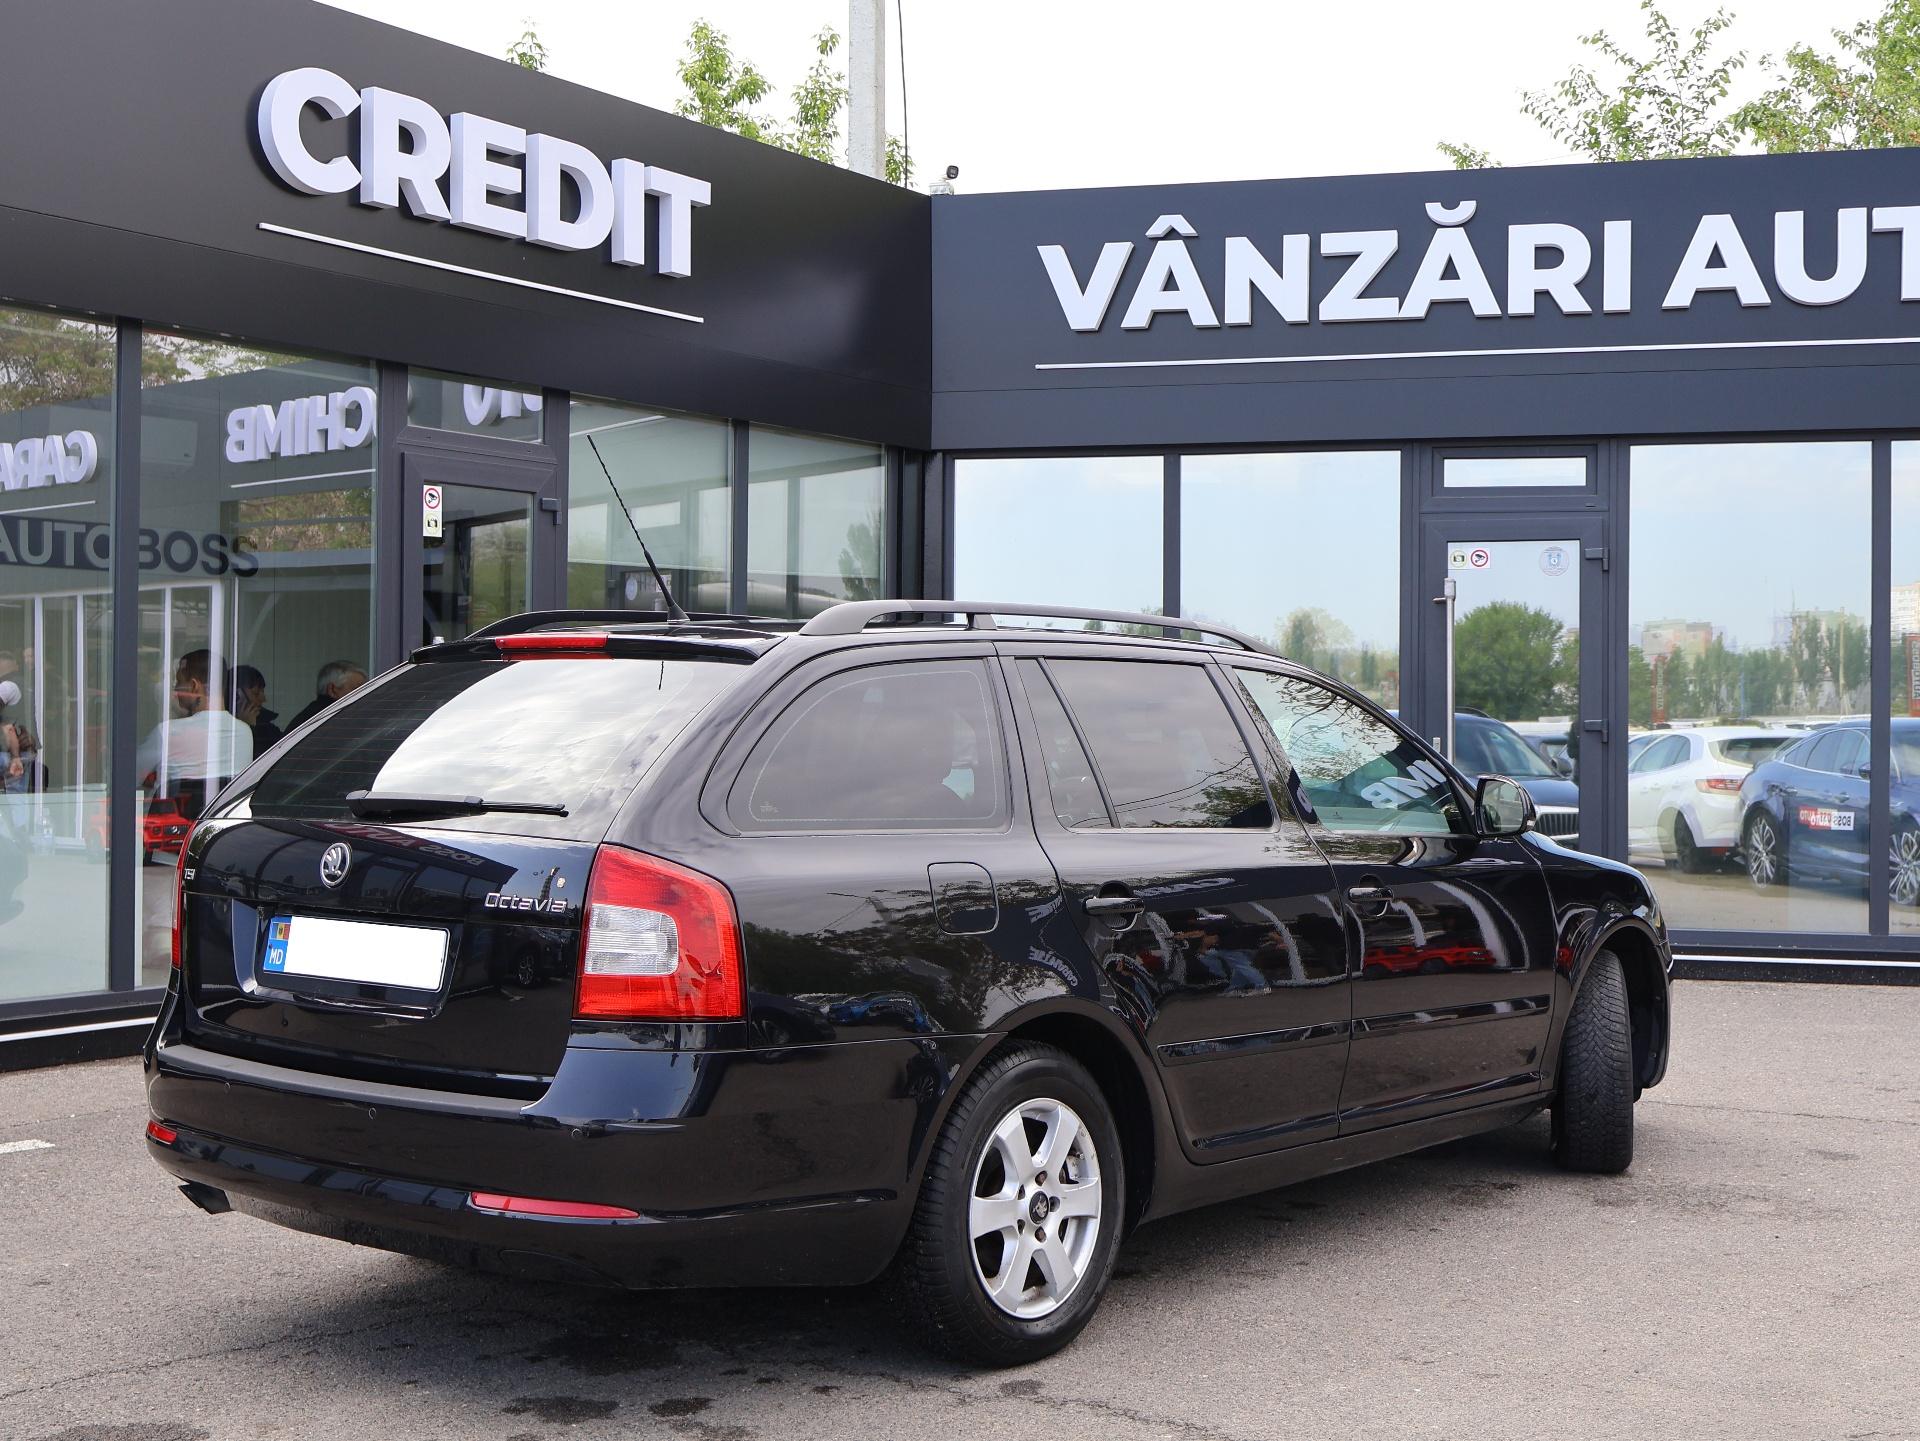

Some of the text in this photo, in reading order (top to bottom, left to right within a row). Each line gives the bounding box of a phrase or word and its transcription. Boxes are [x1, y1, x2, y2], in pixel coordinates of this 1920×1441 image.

[257, 67, 712, 278] CREDIT
[1036, 200, 1920, 332] VÂNZĂRI AUT
[139, 527, 259, 578] BOSS
[484, 892, 568, 914] Octavia
[268, 948, 284, 965] MD
